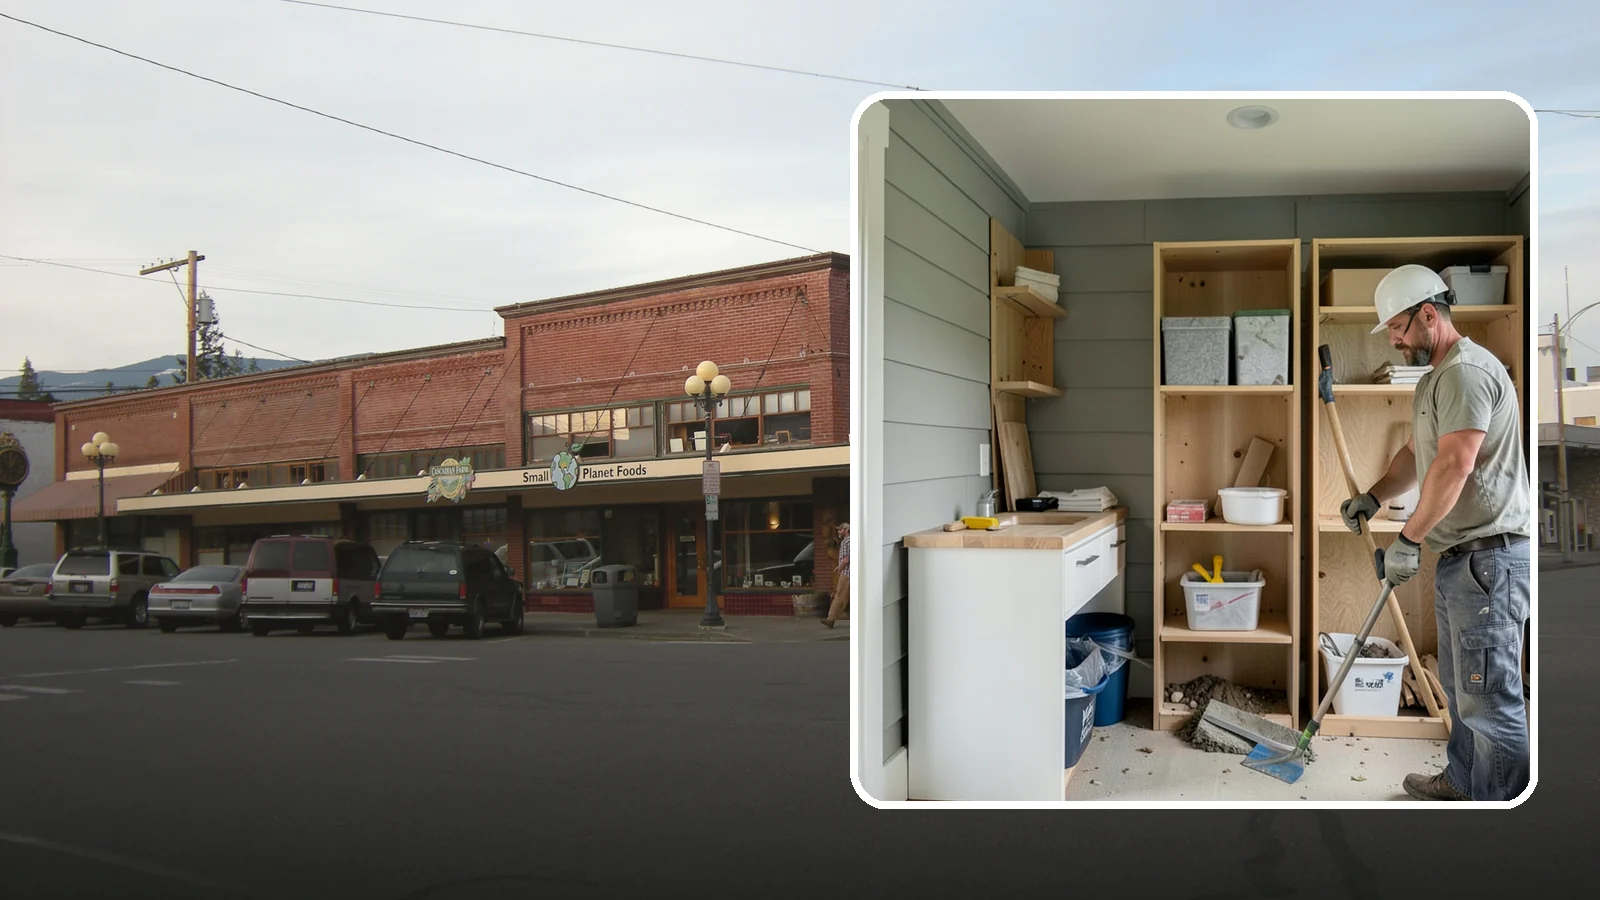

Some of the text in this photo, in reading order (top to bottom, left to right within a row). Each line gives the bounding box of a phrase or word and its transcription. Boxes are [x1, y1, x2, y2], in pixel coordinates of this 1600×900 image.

[523, 464, 647, 482] Small Planet Foods
